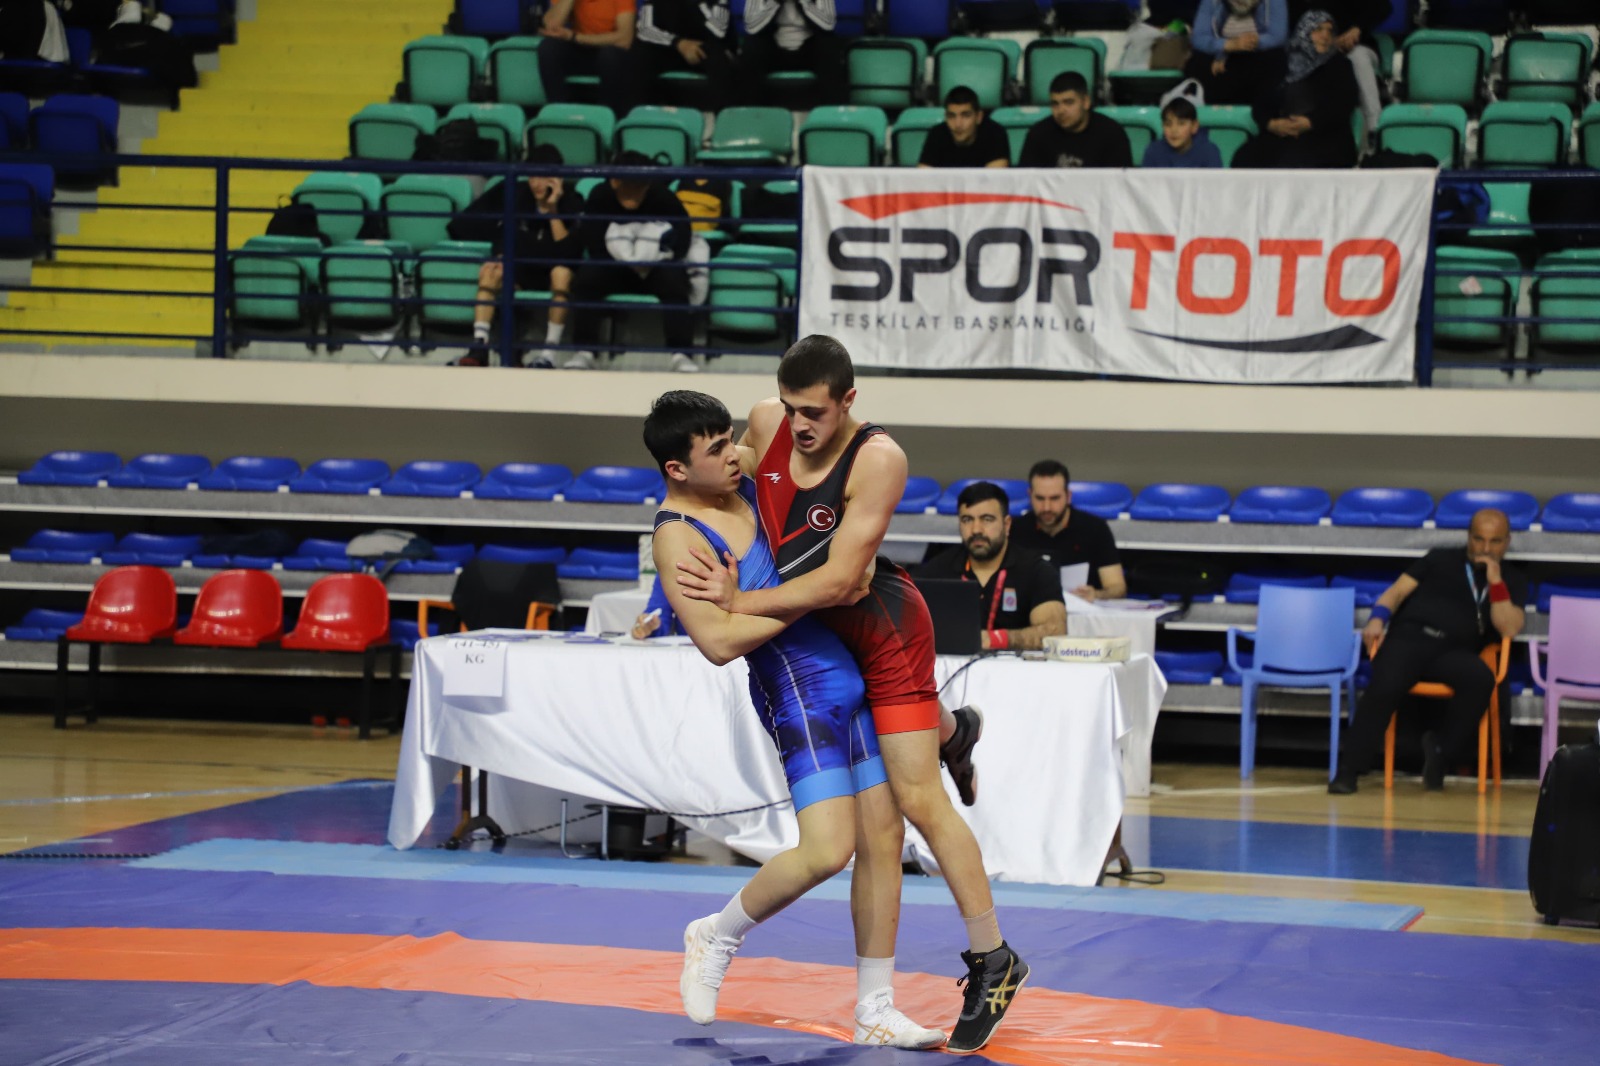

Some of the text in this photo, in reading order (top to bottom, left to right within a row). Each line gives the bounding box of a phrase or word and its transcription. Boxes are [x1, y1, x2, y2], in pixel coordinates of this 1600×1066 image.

[827, 227, 1400, 317] SPOR TOTO
[831, 313, 1095, 333] TEŞKİLAT BAŞKANLIĞI
[465, 653, 485, 664] KG
